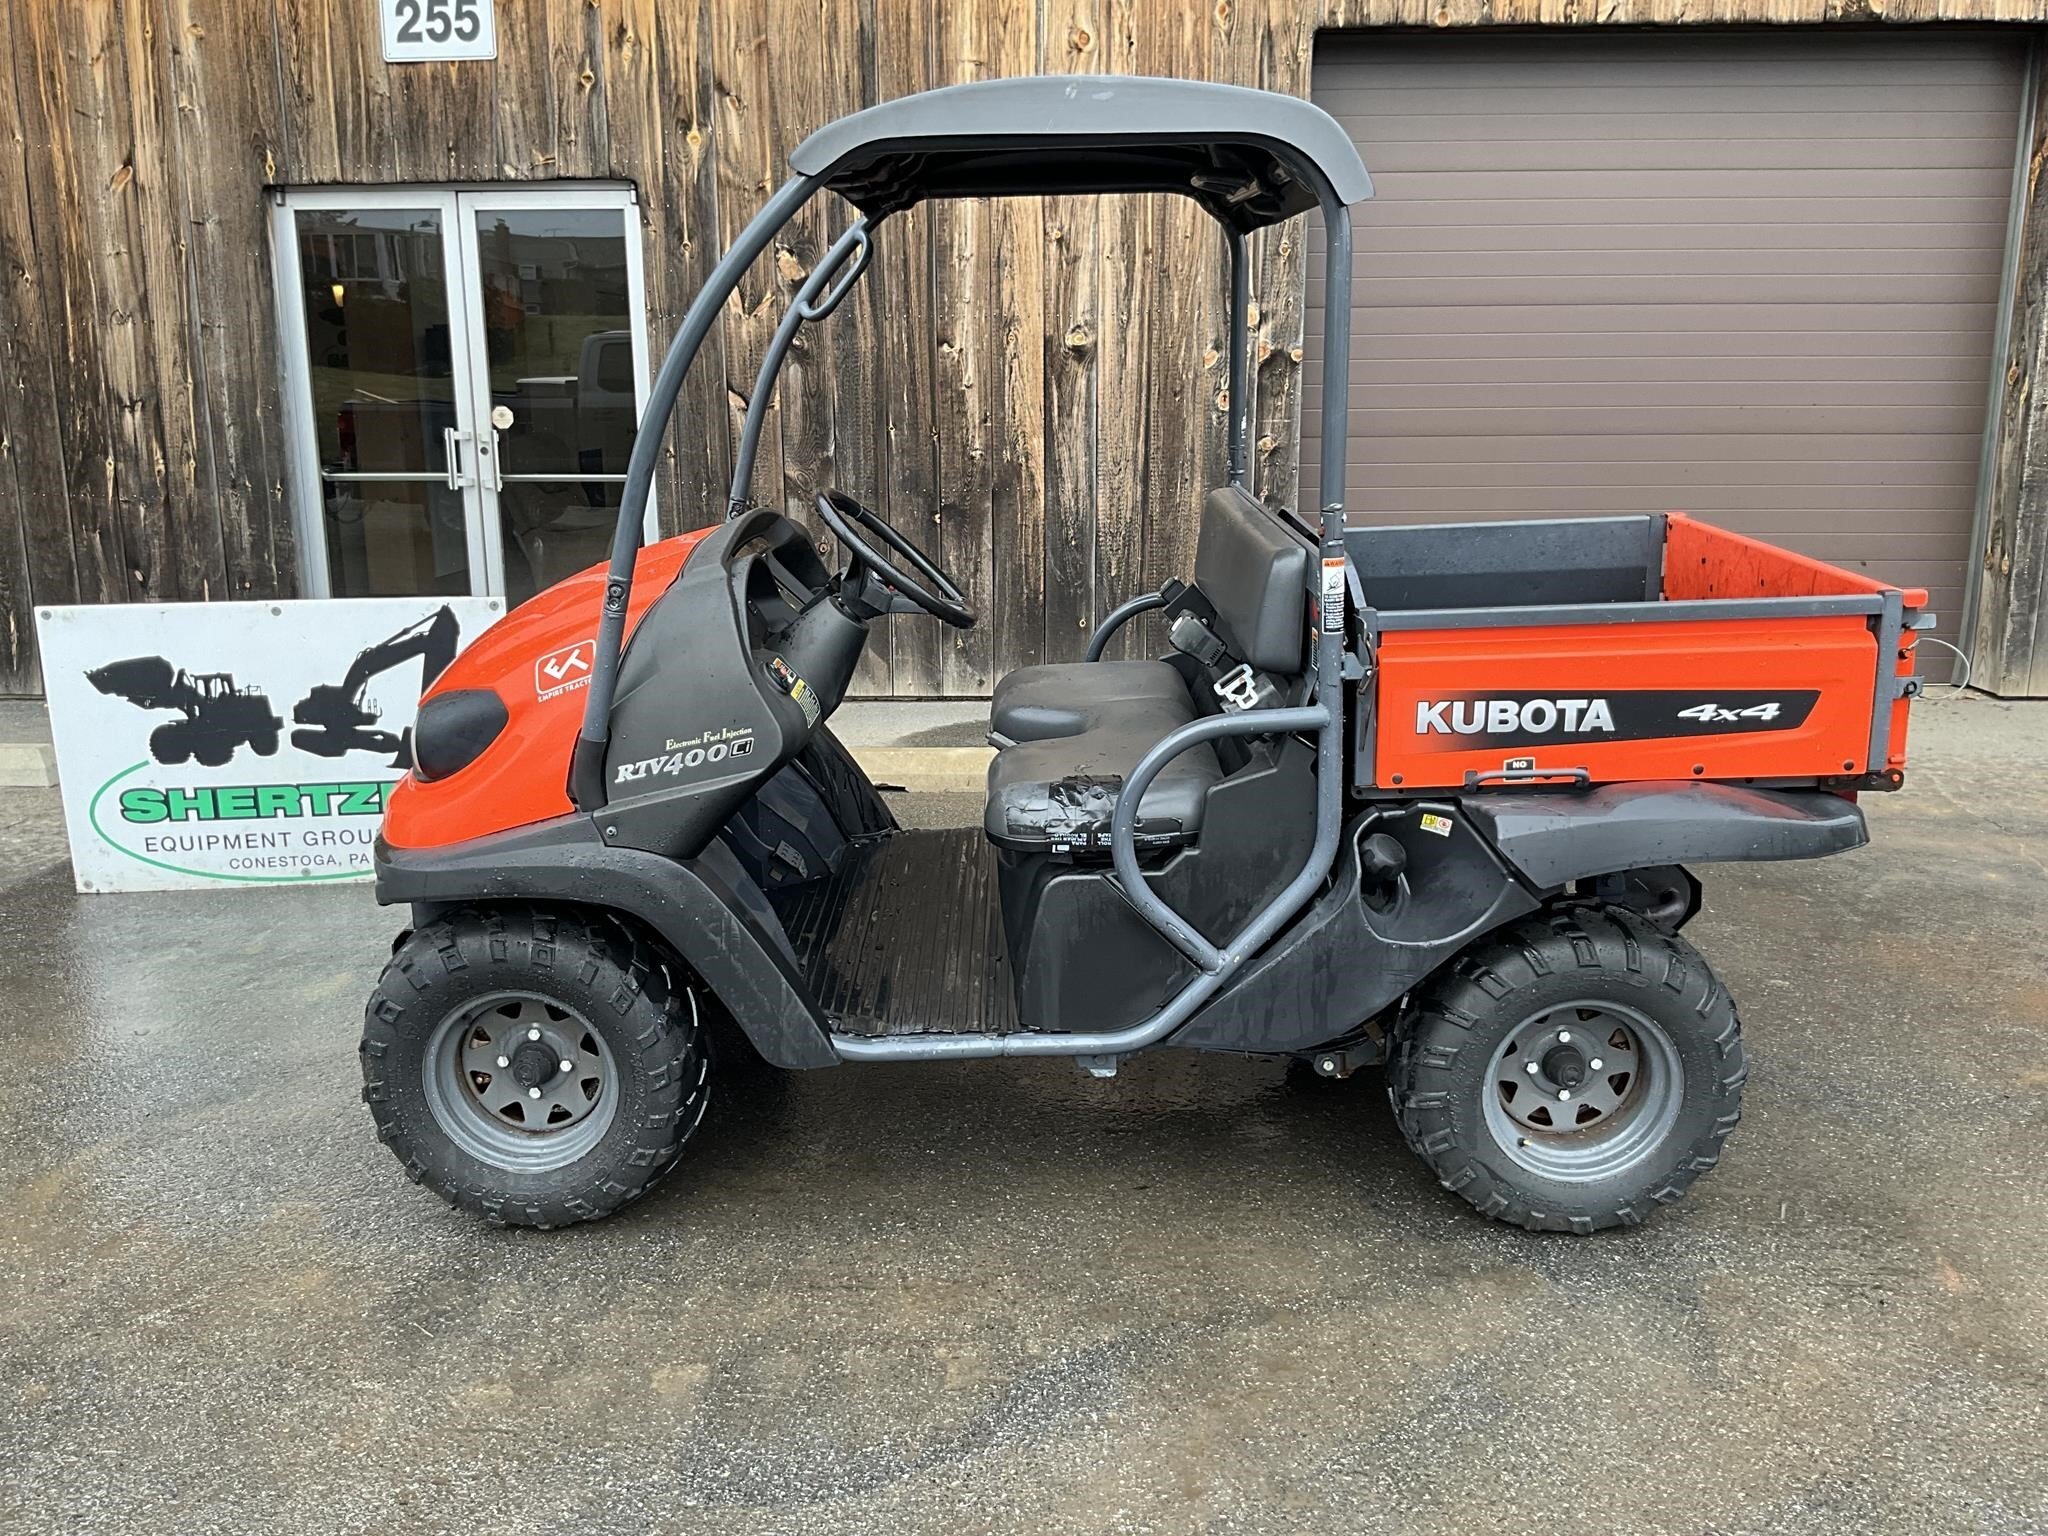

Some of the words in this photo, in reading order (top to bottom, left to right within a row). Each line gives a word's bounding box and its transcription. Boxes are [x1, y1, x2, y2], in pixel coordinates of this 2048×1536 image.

[395, 0, 480, 43] 255
[537, 688, 564, 703] EMPIRE
[1416, 698, 1616, 734] KUBOTA
[1677, 702, 1781, 722] 4x4
[665, 738, 702, 751] Electronic
[703, 731, 721, 743] Fuel
[722, 727, 753, 739] Injection
[1512, 760, 1528, 769] NO
[144, 831, 292, 853] EQUIPMENT
[303, 828, 379, 846] GROU
[229, 854, 342, 869] CONESTOGA,
[349, 853, 370, 864] PA
